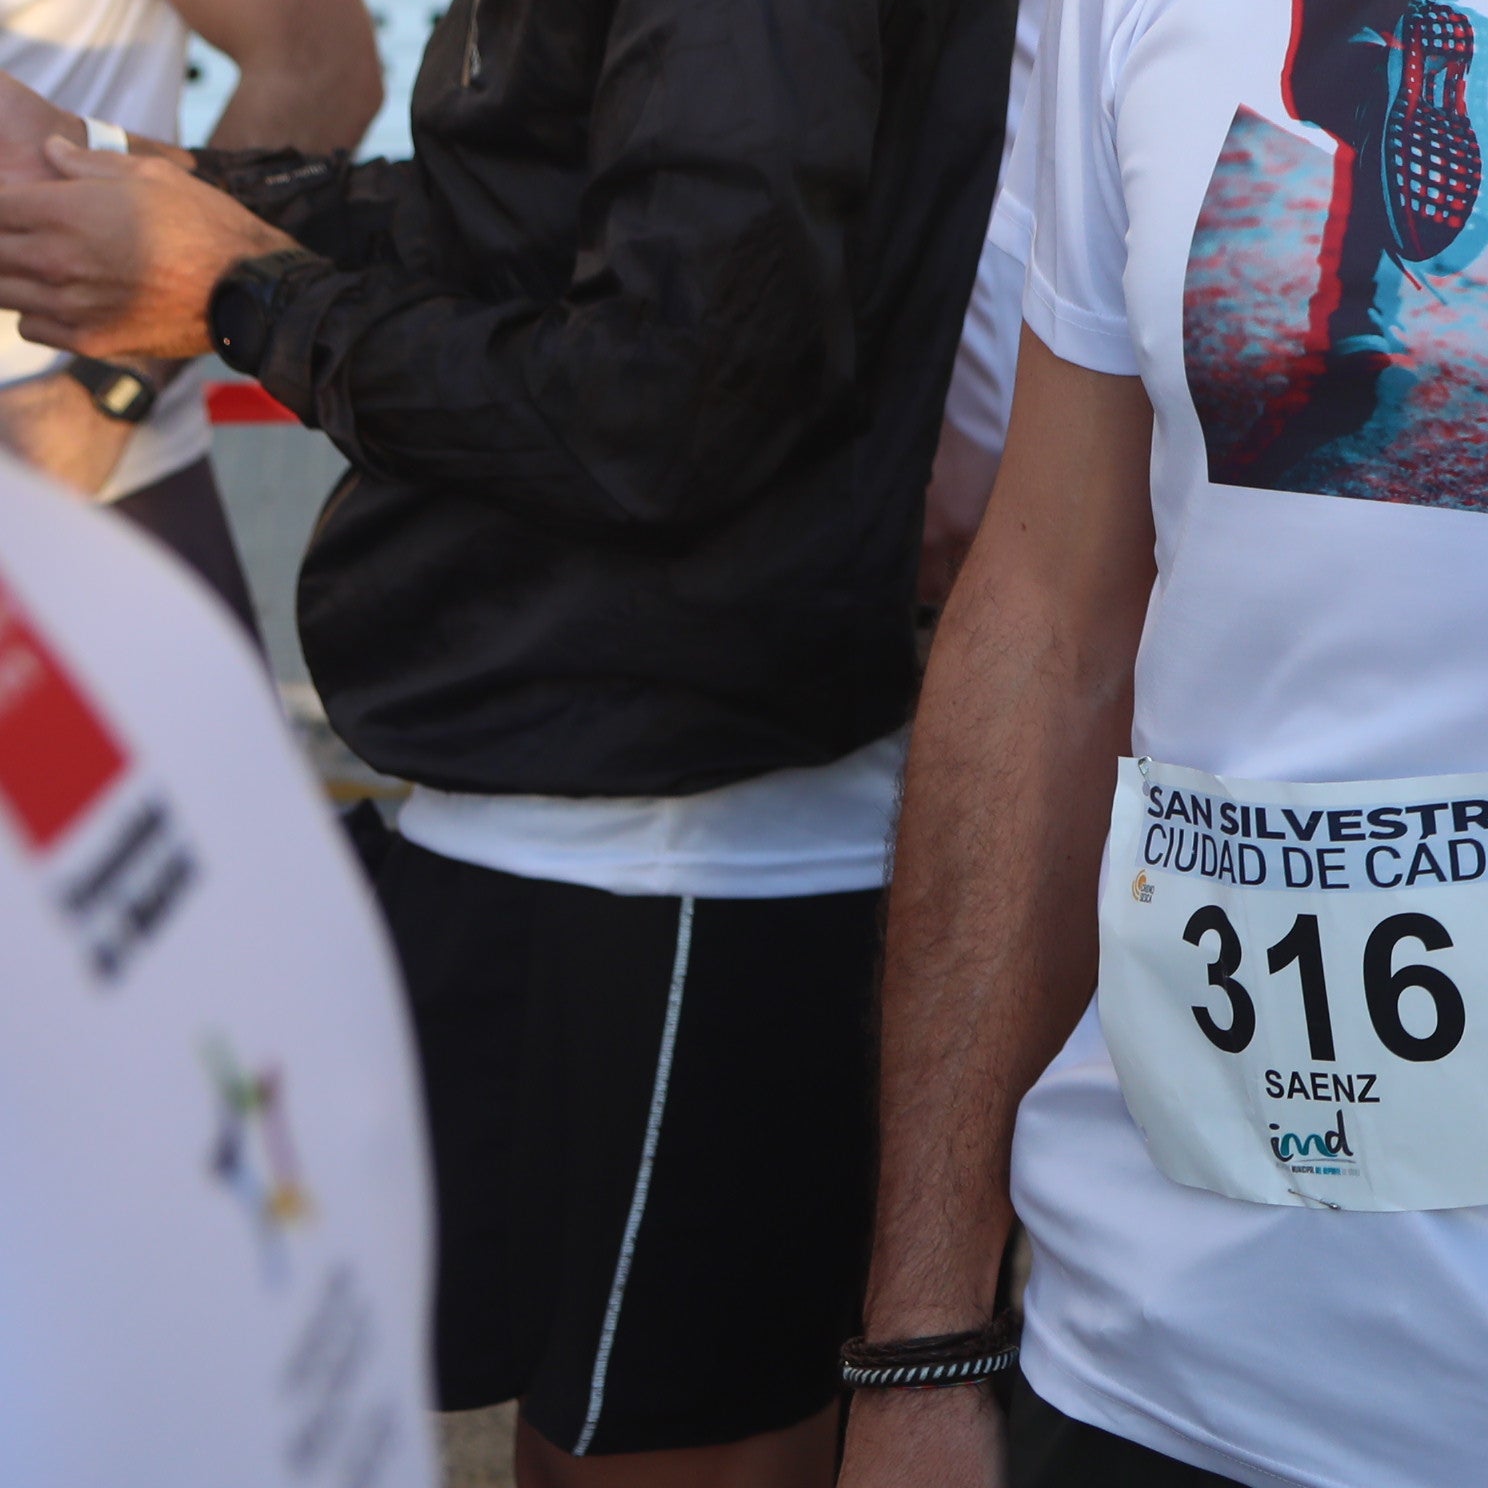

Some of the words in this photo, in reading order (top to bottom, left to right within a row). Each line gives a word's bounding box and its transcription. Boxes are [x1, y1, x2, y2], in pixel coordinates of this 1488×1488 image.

[1148, 785, 1213, 830] SAN
[1144, 823, 1267, 886] CIUDAD
[1282, 847, 1350, 890] DE
[1182, 904, 1466, 1063] 316
[1265, 1069, 1380, 1103] SAENZ
